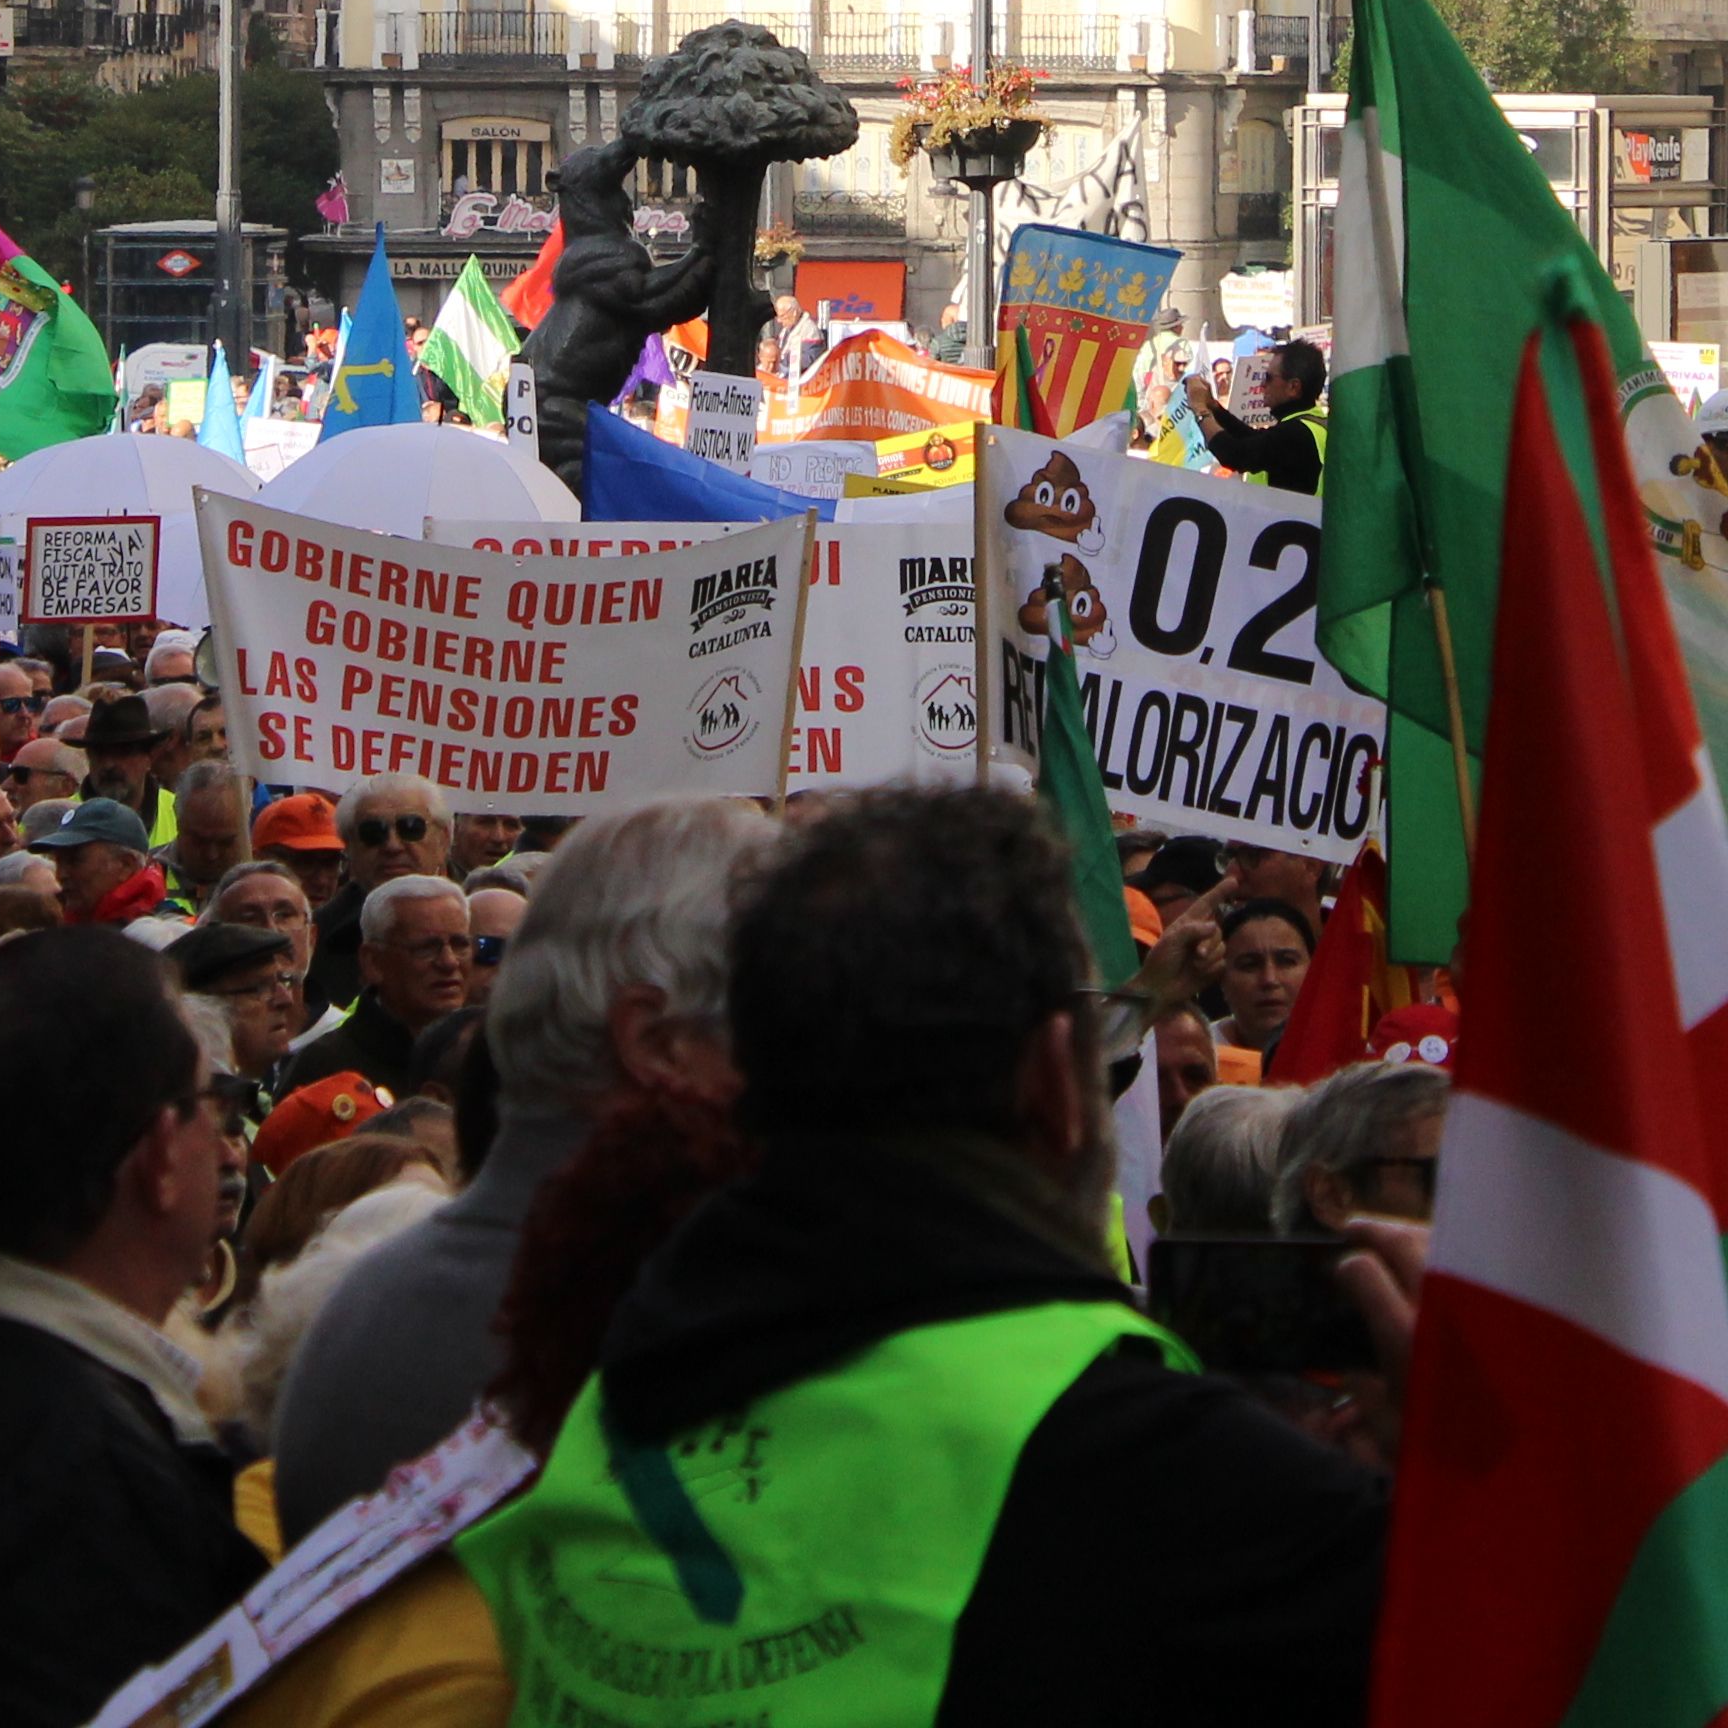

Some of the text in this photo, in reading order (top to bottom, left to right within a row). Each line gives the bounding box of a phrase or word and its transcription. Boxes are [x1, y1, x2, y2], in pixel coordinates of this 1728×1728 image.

[394, 262, 413, 276] LA
[44, 531, 118, 547] REFORMA
[43, 548, 102, 564] FISCAL
[42, 561, 144, 582] QUITAR TRATO
[227, 519, 662, 626] GOBIERNE QUIEN
[691, 555, 778, 615] MAREA
[41, 577, 142, 598] DE FAVOR
[43, 595, 142, 617] EMPRESAS
[305, 600, 567, 684] GOBIERNE
[688, 620, 772, 659] CATALUNYA
[237, 647, 640, 740] LAS PENSIONES
[258, 712, 610, 794] SE DEFIENDEN
